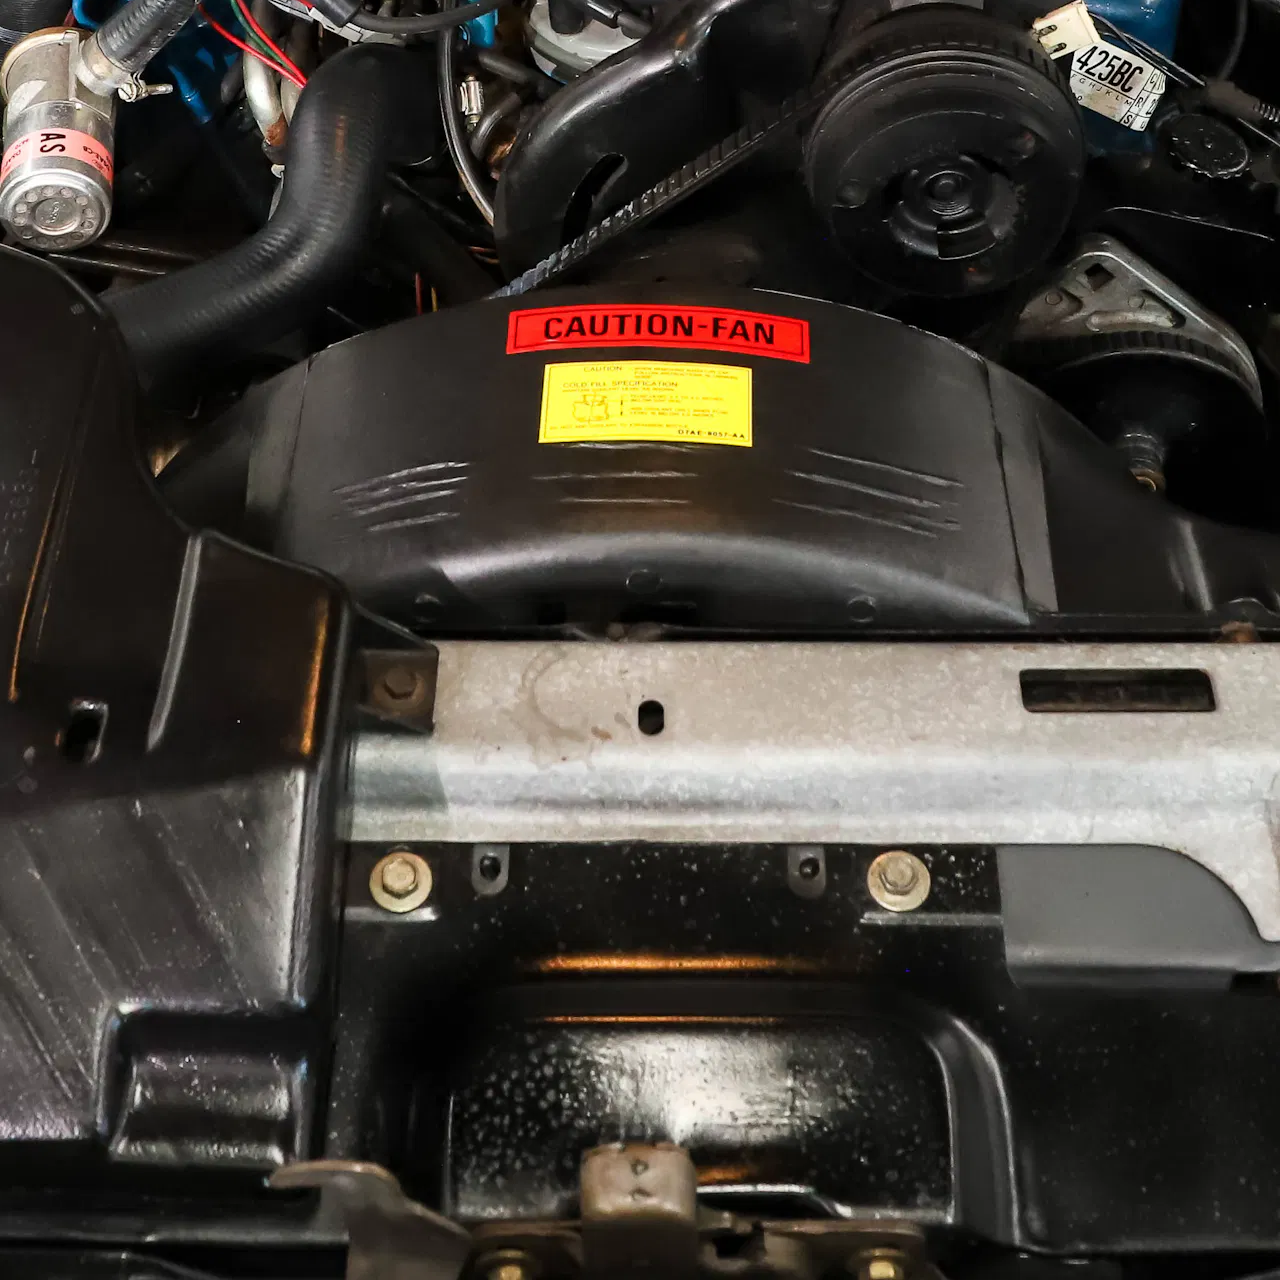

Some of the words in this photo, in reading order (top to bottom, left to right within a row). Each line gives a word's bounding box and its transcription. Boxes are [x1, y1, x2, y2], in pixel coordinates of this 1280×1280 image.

[1076, 46, 1144, 93] 425BC
[40, 132, 67, 154] AS
[543, 311, 775, 346] CAUTION-FAN
[583, 365, 623, 373] CAUTION
[562, 381, 588, 389] COLD
[611, 379, 678, 388] SPECIFICATION
